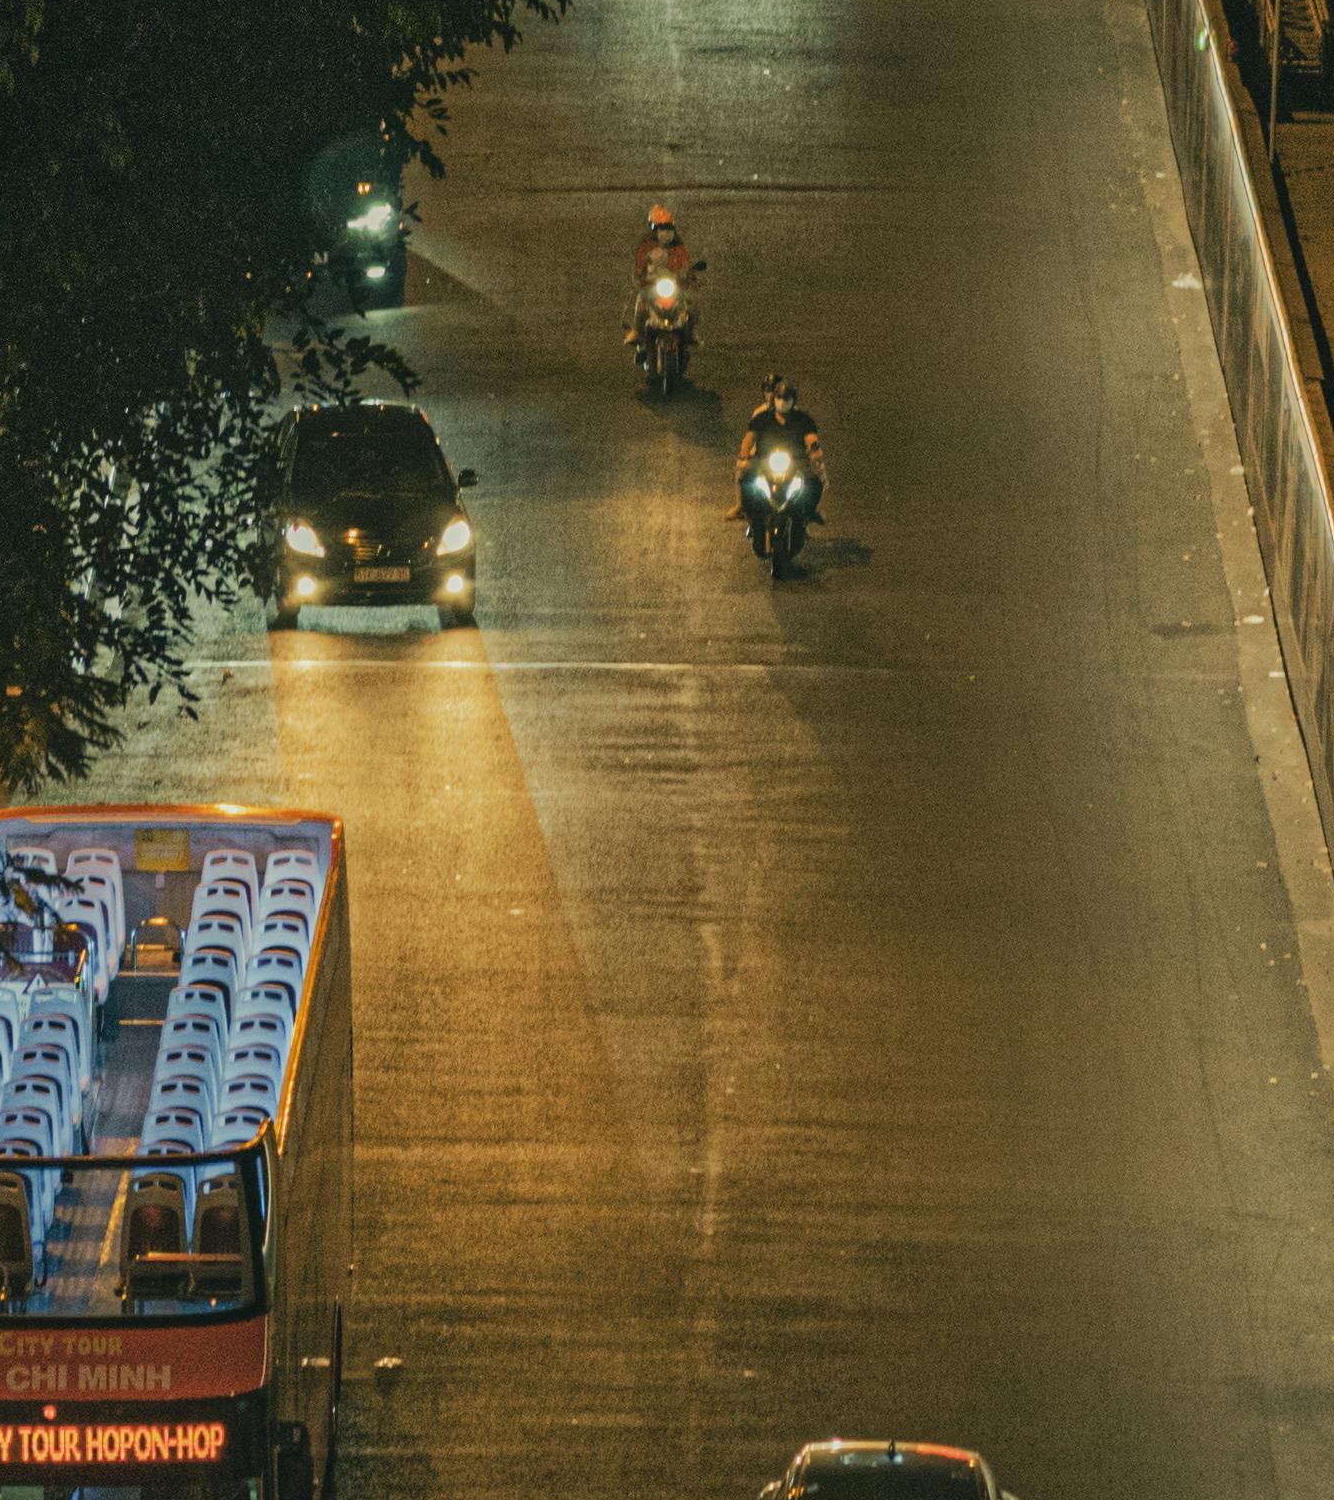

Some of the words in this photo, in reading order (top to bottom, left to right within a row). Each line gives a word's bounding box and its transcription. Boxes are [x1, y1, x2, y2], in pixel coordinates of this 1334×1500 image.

[6, 1364, 67, 1391] CHI
[78, 1363, 171, 1391] MINH
[18, 1424, 81, 1462] TOUR
[86, 1422, 225, 1462] HOPON-HOP
